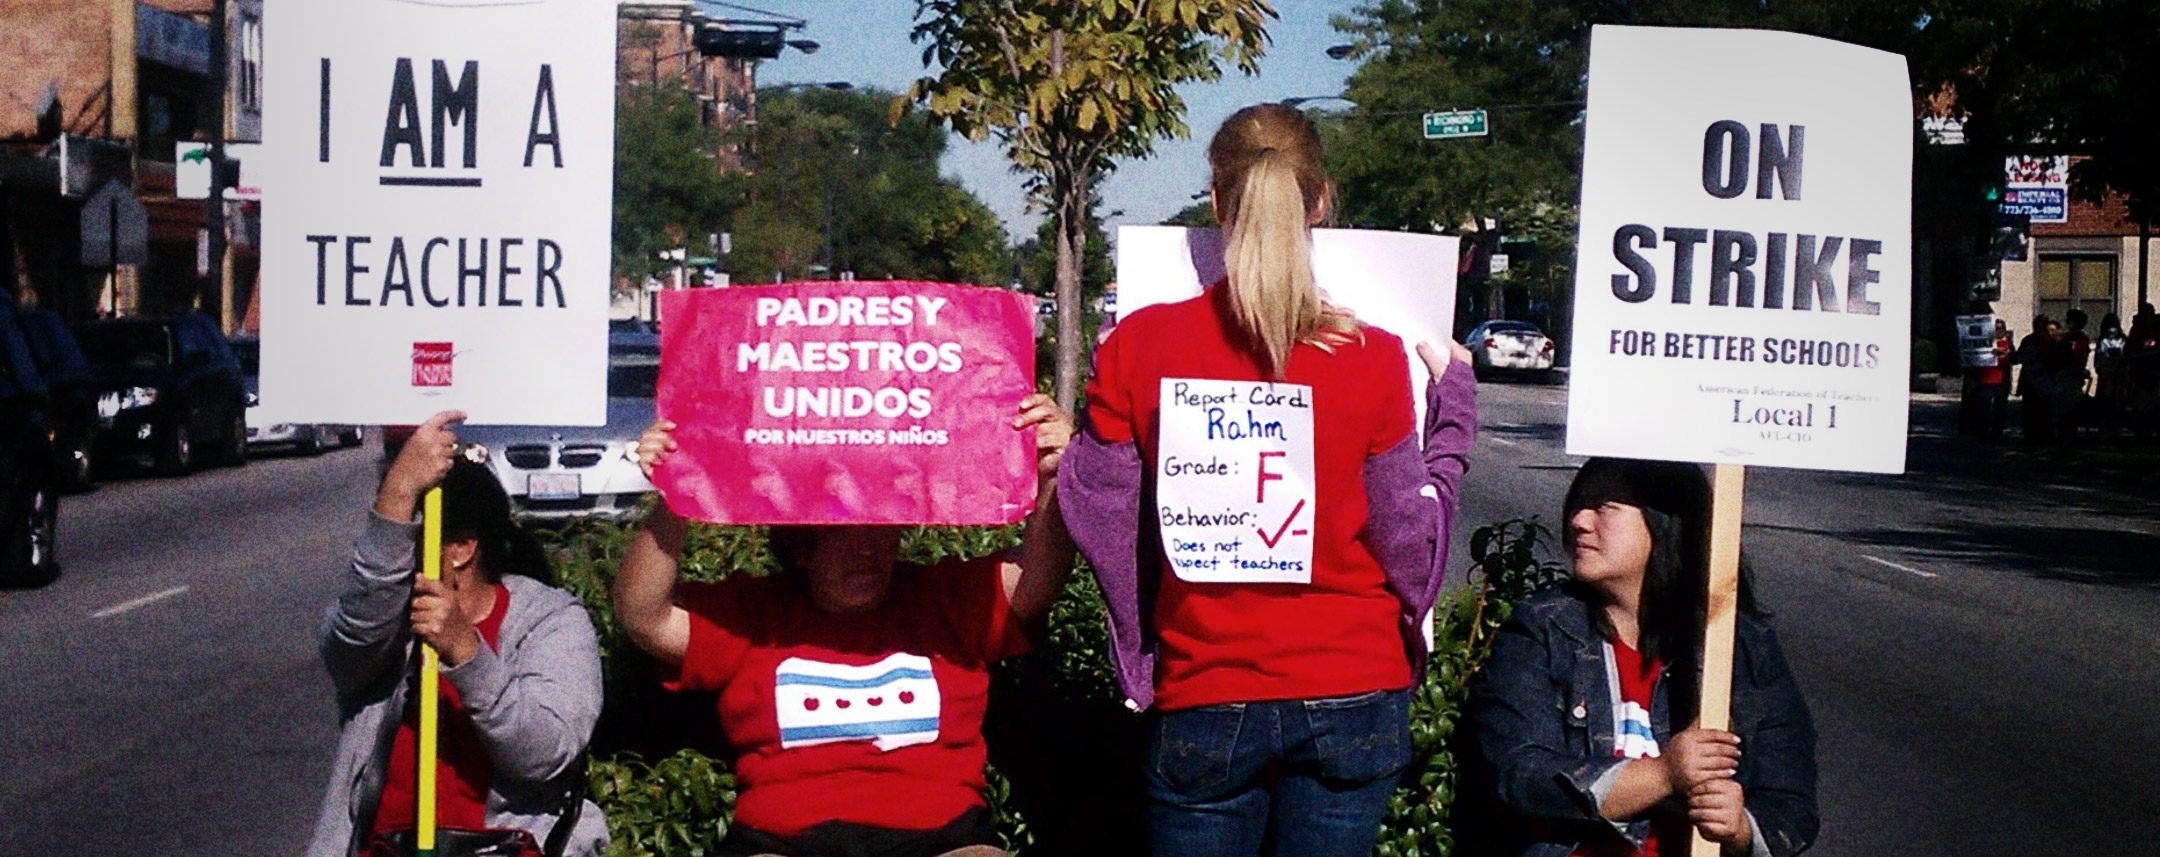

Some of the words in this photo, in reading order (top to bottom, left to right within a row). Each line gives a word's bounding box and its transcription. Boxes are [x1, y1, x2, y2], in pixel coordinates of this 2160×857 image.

[319, 57, 331, 163] I
[379, 57, 479, 168] AM
[523, 63, 564, 169] A
[1701, 119, 1805, 201] ON
[307, 235, 566, 309] TEACHER
[1611, 223, 1883, 316] STRIKE
[756, 295, 914, 328] PADRES
[916, 295, 948, 328] Y
[737, 341, 962, 375] MAESTROS
[1609, 329, 1656, 357] FOR
[1664, 331, 1755, 363] BETTER
[1762, 337, 1881, 369] SCHOOLS
[764, 387, 932, 419] UNIDOS
[1174, 382, 1238, 412] Report
[1249, 386, 1309, 408] Card
[1207, 407, 1288, 441] Rahm
[1731, 399, 1814, 428] Local
[1826, 404, 1838, 429] 1
[744, 428, 785, 445] POR
[786, 428, 886, 446] NUESTROS
[888, 425, 949, 446] NIÑOS
[1257, 451, 1287, 503] F
[1161, 506, 1258, 528] Behavior:
[1172, 537, 1206, 552] Does
[1214, 535, 1243, 552] not
[1230, 554, 1304, 571] teachers
